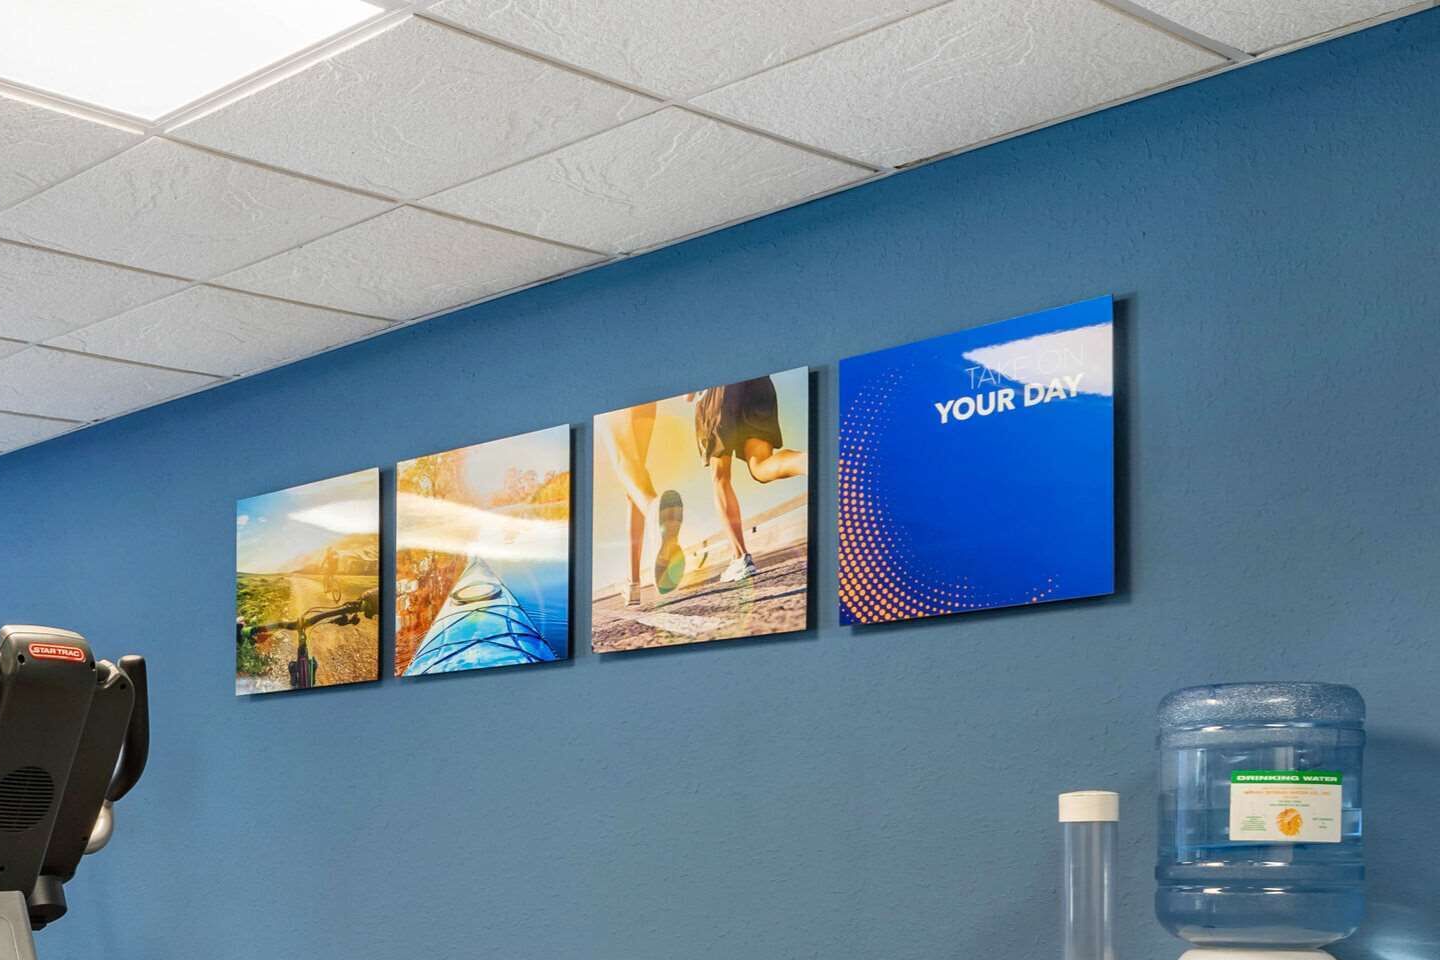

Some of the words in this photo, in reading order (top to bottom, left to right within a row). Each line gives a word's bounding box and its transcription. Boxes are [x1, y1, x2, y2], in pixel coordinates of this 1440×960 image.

[934, 388, 1016, 424] YOUR
[1023, 371, 1085, 408] DAY
[32, 646, 56, 655] STAR
[57, 649, 80, 657] TRAC
